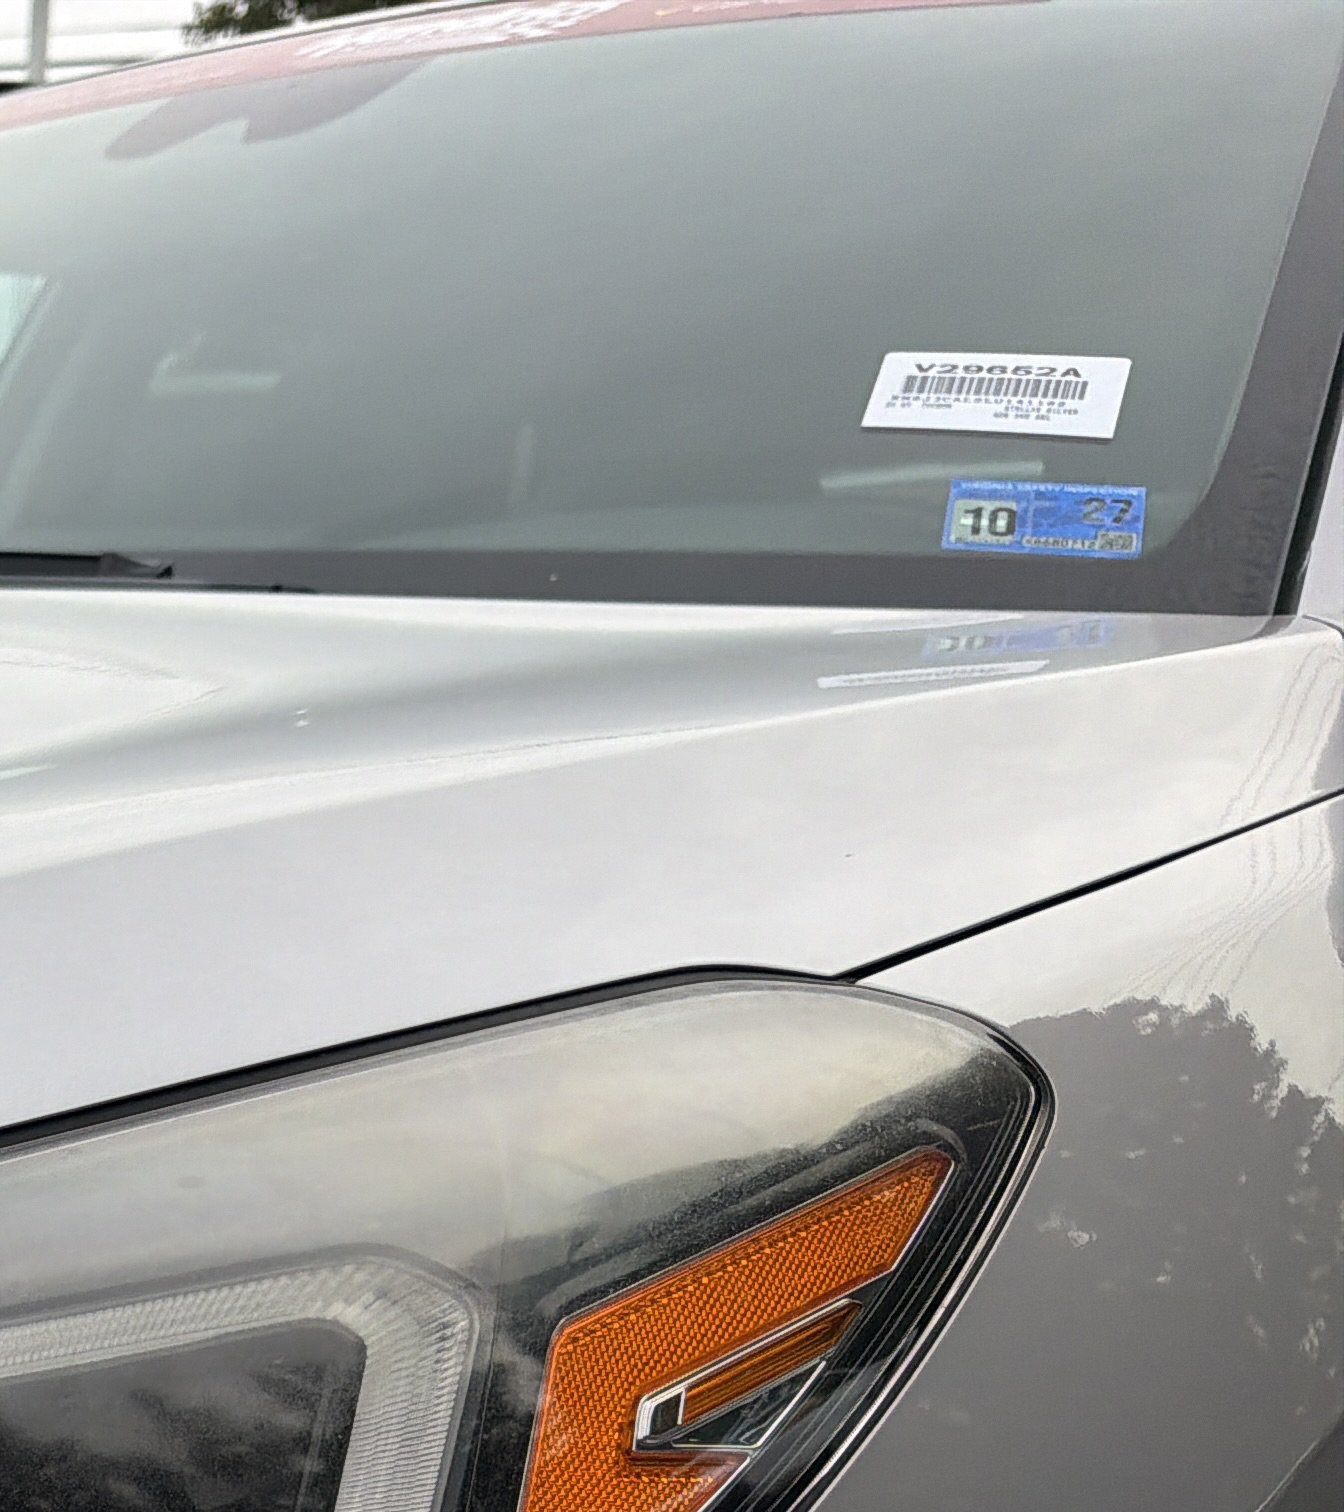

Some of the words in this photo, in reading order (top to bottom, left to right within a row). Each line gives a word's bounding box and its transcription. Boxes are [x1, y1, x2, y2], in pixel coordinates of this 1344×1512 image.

[914, 363, 1082, 379] V29652A
[963, 506, 1017, 537] 10
[1082, 496, 1134, 525] 27
